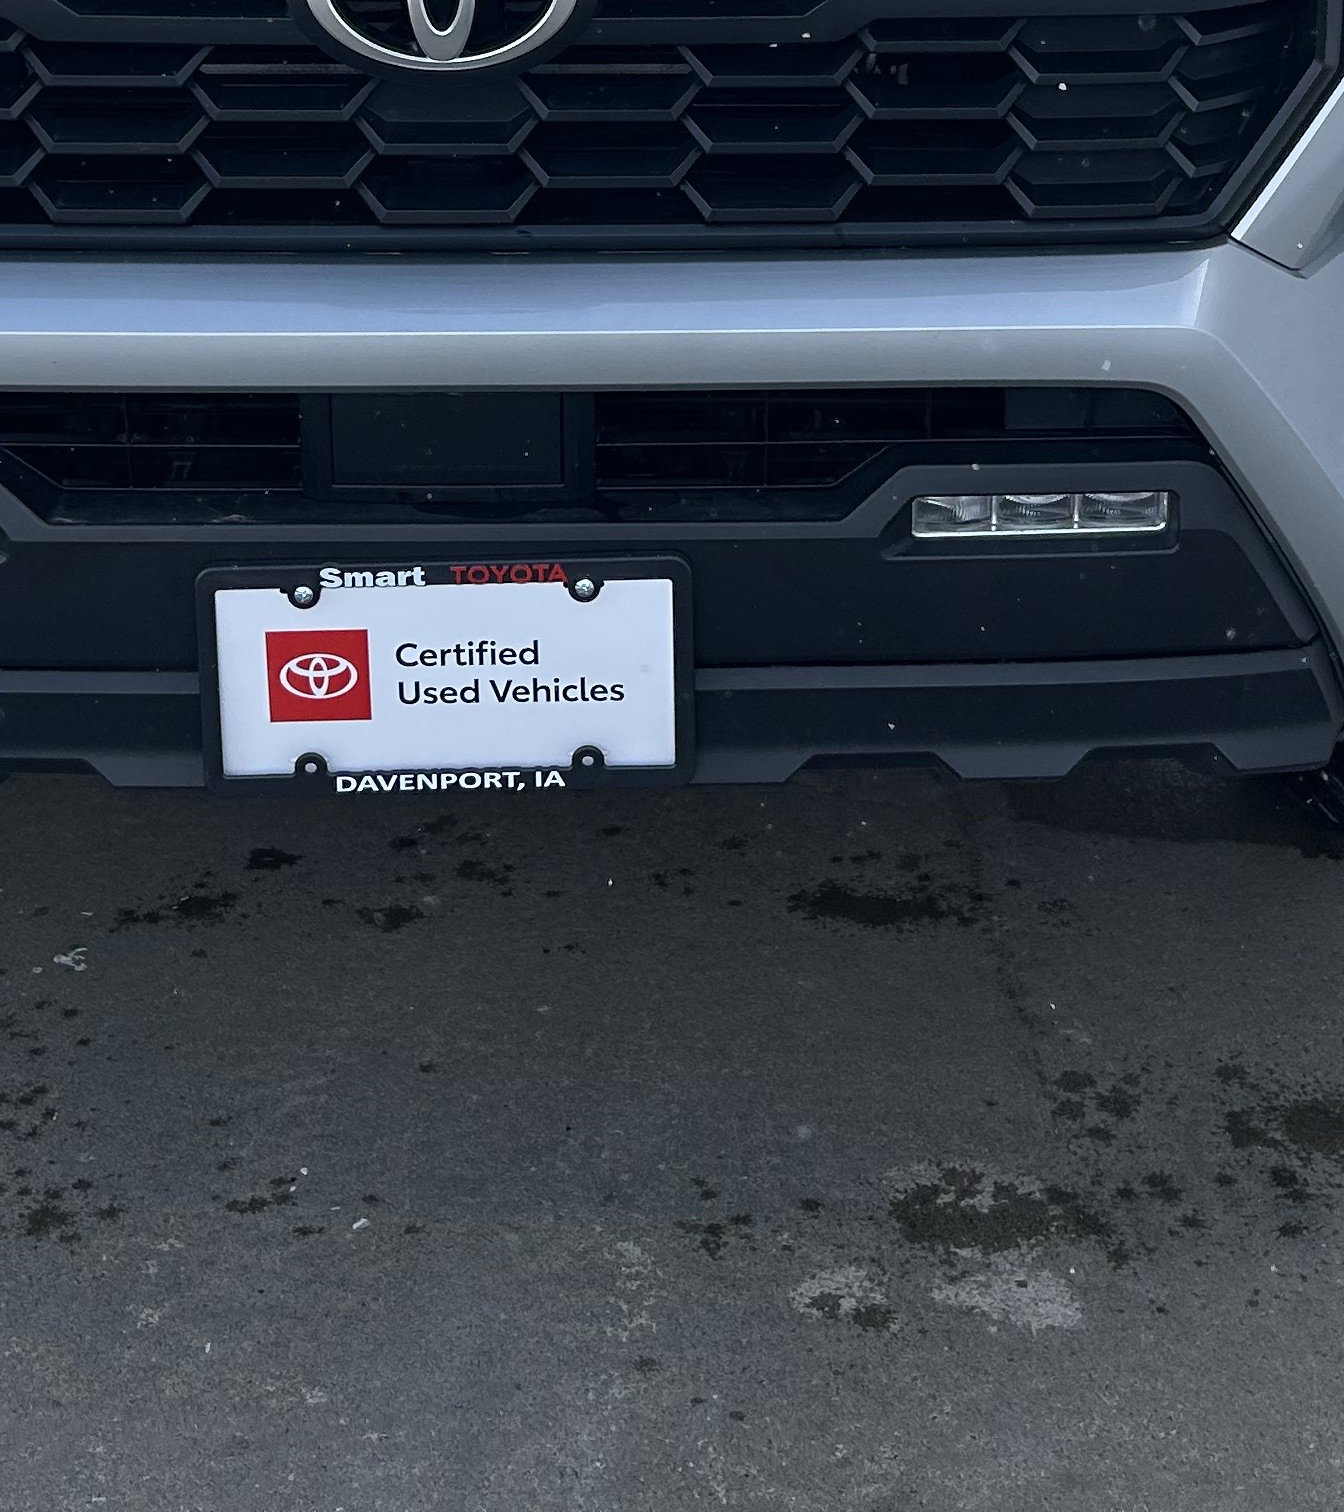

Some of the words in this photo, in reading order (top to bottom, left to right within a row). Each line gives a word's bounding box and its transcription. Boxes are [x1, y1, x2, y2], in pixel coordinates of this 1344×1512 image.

[319, 566, 426, 589] Smart
[450, 563, 569, 585] TOYOTA
[395, 639, 540, 668] Certified
[398, 678, 480, 705] Used
[490, 676, 625, 704] Vehicles
[335, 771, 526, 793] DAVENPORT,
[535, 769, 567, 788] IA
